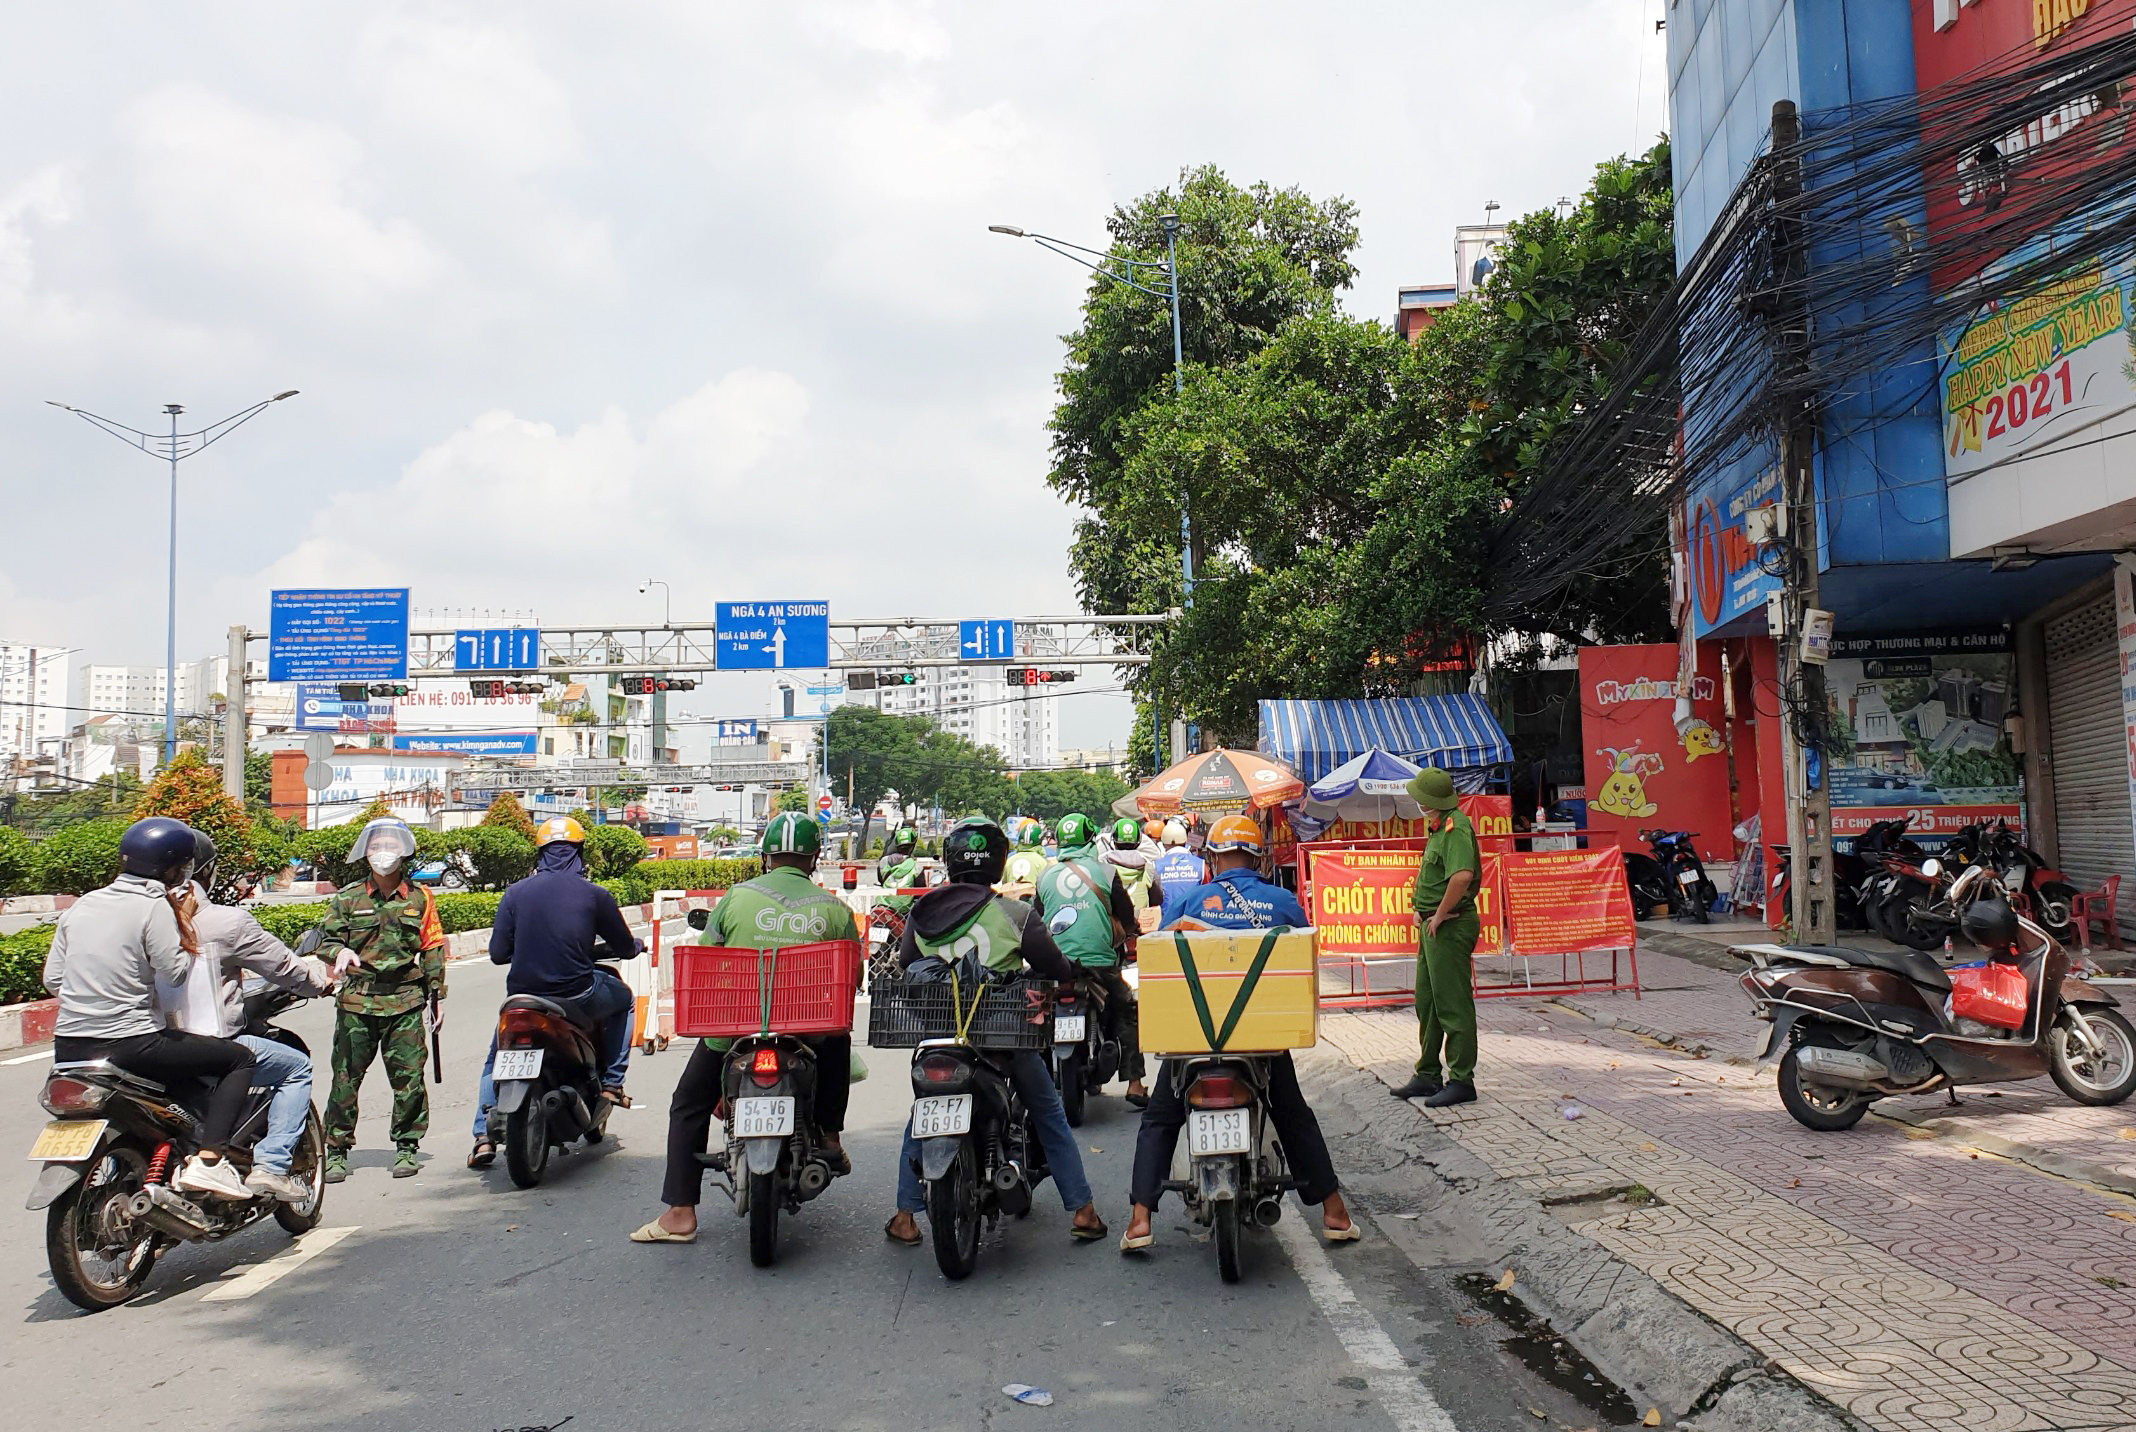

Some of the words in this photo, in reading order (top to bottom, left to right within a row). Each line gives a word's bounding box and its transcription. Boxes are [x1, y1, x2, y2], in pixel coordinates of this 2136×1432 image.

[1948, 351, 2007, 408] HAPPY
[2009, 326, 2053, 377] NEW
[2058, 290, 2122, 348] YEAR!
[1985, 360, 2072, 440] 2021
[731, 604, 755, 617] NGÃ
[757, 605, 765, 617] 4
[768, 605, 784, 617] AN
[787, 603, 827, 617] SƯƠNG
[773, 618, 778, 626] 2
[778, 618, 786, 626] km
[718, 631, 733, 640] NGÃ
[734, 632, 739, 640] 4
[740, 630, 749, 640] BÀ
[1849, 639, 1872, 652] HỢP
[1875, 637, 1922, 650] THƯƠNG
[1924, 636, 1947, 650] MẠI
[1951, 636, 1959, 647] &
[1963, 634, 1987, 646] CĂN
[1991, 633, 2006, 647] HỘ
[733, 642, 738, 651] 2
[738, 642, 749, 651] km
[409, 740, 442, 751] Website:
[1848, 816, 1871, 828] CHO
[1938, 815, 1970, 827] TRIỆU
[1907, 809, 1935, 831] 25
[964, 851, 990, 860] gojek
[1343, 853, 1356, 866] ỦY
[1358, 855, 1376, 866] BAN
[1380, 854, 1406, 866] NHÂN
[1161, 872, 1180, 880] LONG
[1180, 869, 1199, 879] CHÂU
[1322, 877, 1376, 915] CHỐT
[1381, 876, 1416, 914] KIỂ
[755, 907, 827, 936] Grab
[1218, 912, 1234, 920] CAO
[1319, 920, 1361, 945] PHÒNG
[1364, 918, 1407, 945] CHỐNG
[502, 1051, 537, 1064] 52-Y5
[499, 1065, 534, 1077] 7820
[744, 1100, 786, 1116] 54-V6
[922, 1098, 964, 1116] 52-F7
[743, 1117, 785, 1133] 8067
[921, 1114, 962, 1134] 9696
[1199, 1112, 1241, 1131] 51-S3
[1200, 1131, 1242, 1151] 8139
